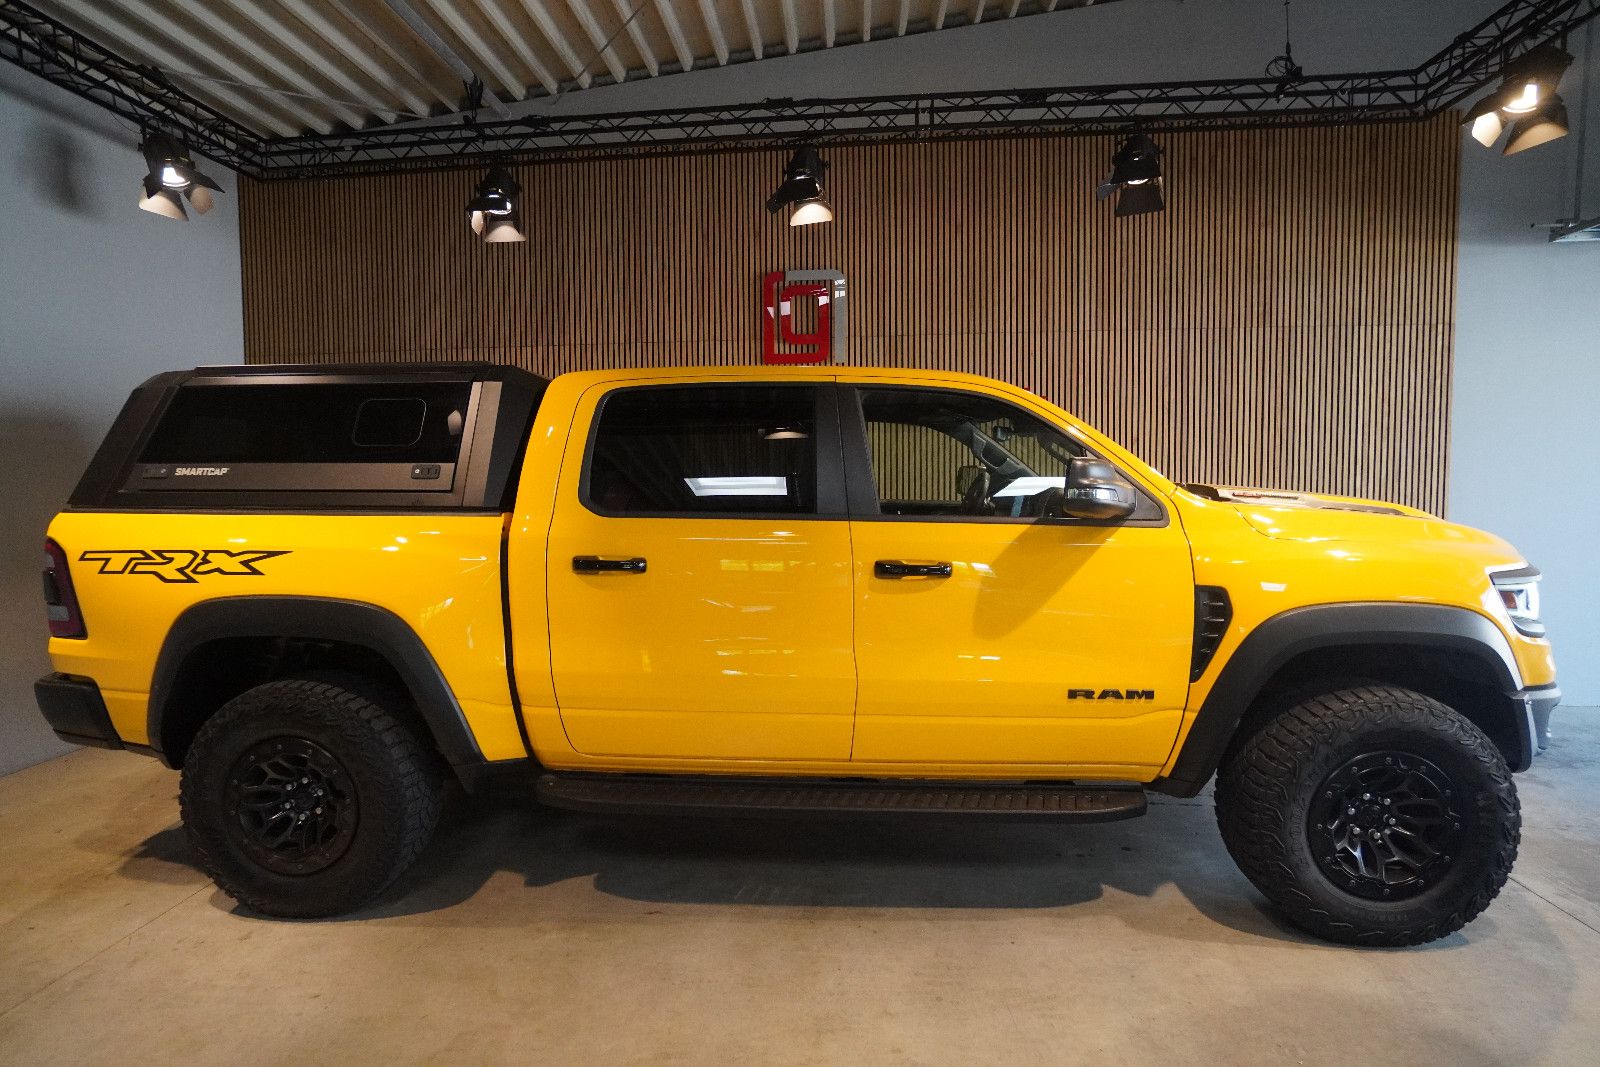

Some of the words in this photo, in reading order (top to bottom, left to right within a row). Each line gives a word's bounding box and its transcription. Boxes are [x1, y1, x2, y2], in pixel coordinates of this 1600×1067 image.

[175, 467, 229, 476] SMARTCAP
[78, 549, 294, 584] TRX
[1067, 688, 1154, 700] RAM
